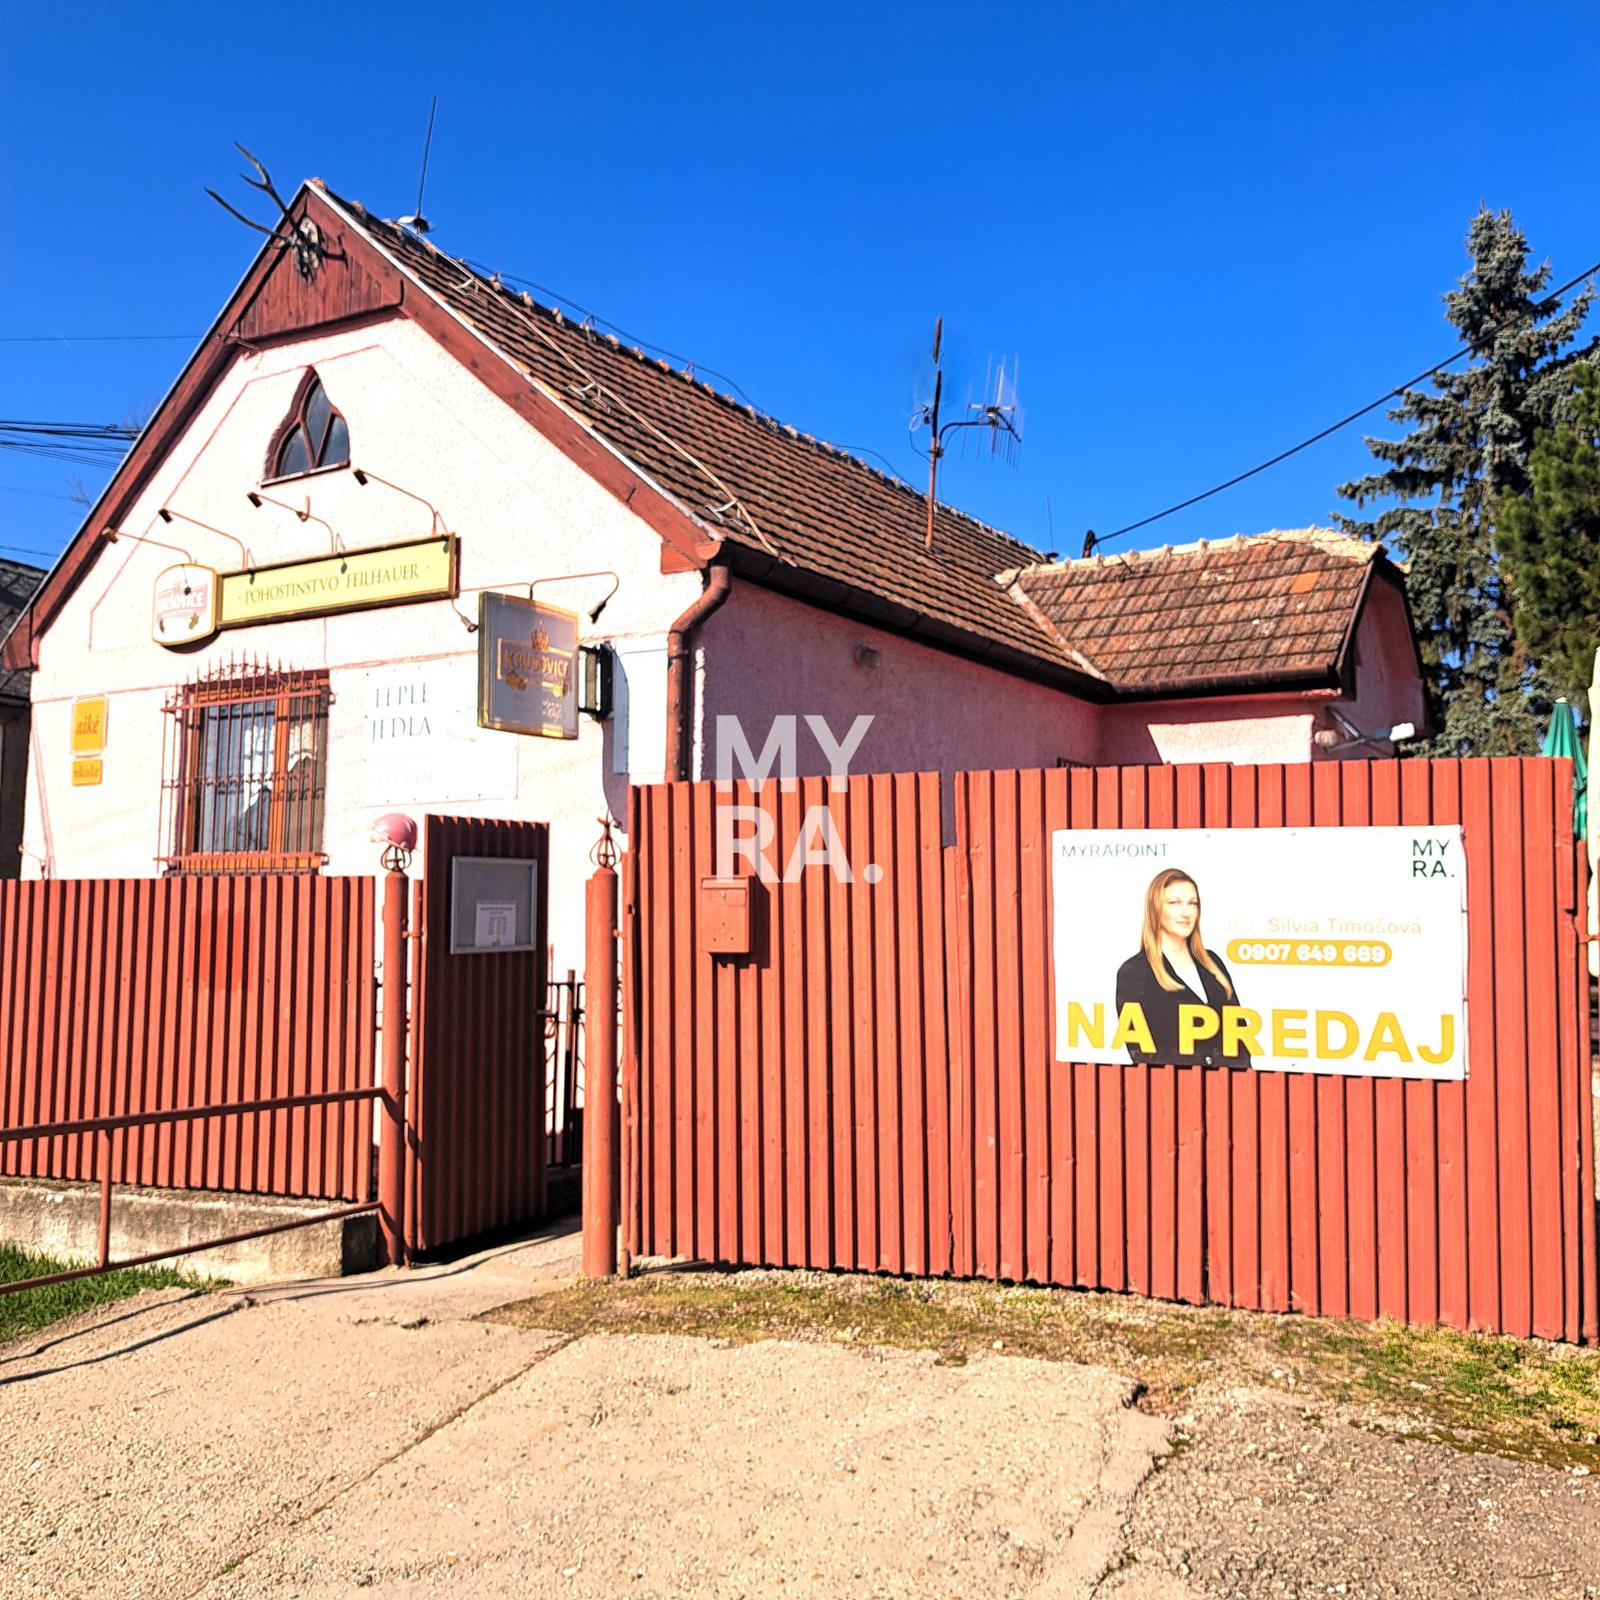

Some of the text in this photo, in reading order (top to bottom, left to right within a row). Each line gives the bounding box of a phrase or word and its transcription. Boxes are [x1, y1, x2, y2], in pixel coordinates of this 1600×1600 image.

[244, 563, 419, 605] POHOSTINSTVO FEILHAUER
[1062, 843, 1168, 858] MYRAPOINT
[1412, 839, 1450, 857] MY
[1412, 860, 1455, 878] RA.
[1268, 917, 1319, 933] Silvia
[1327, 916, 1422, 934] Timošová
[1238, 943, 1386, 963] 0907 649 669
[1067, 1002, 1455, 1065] NA PREDAJ
